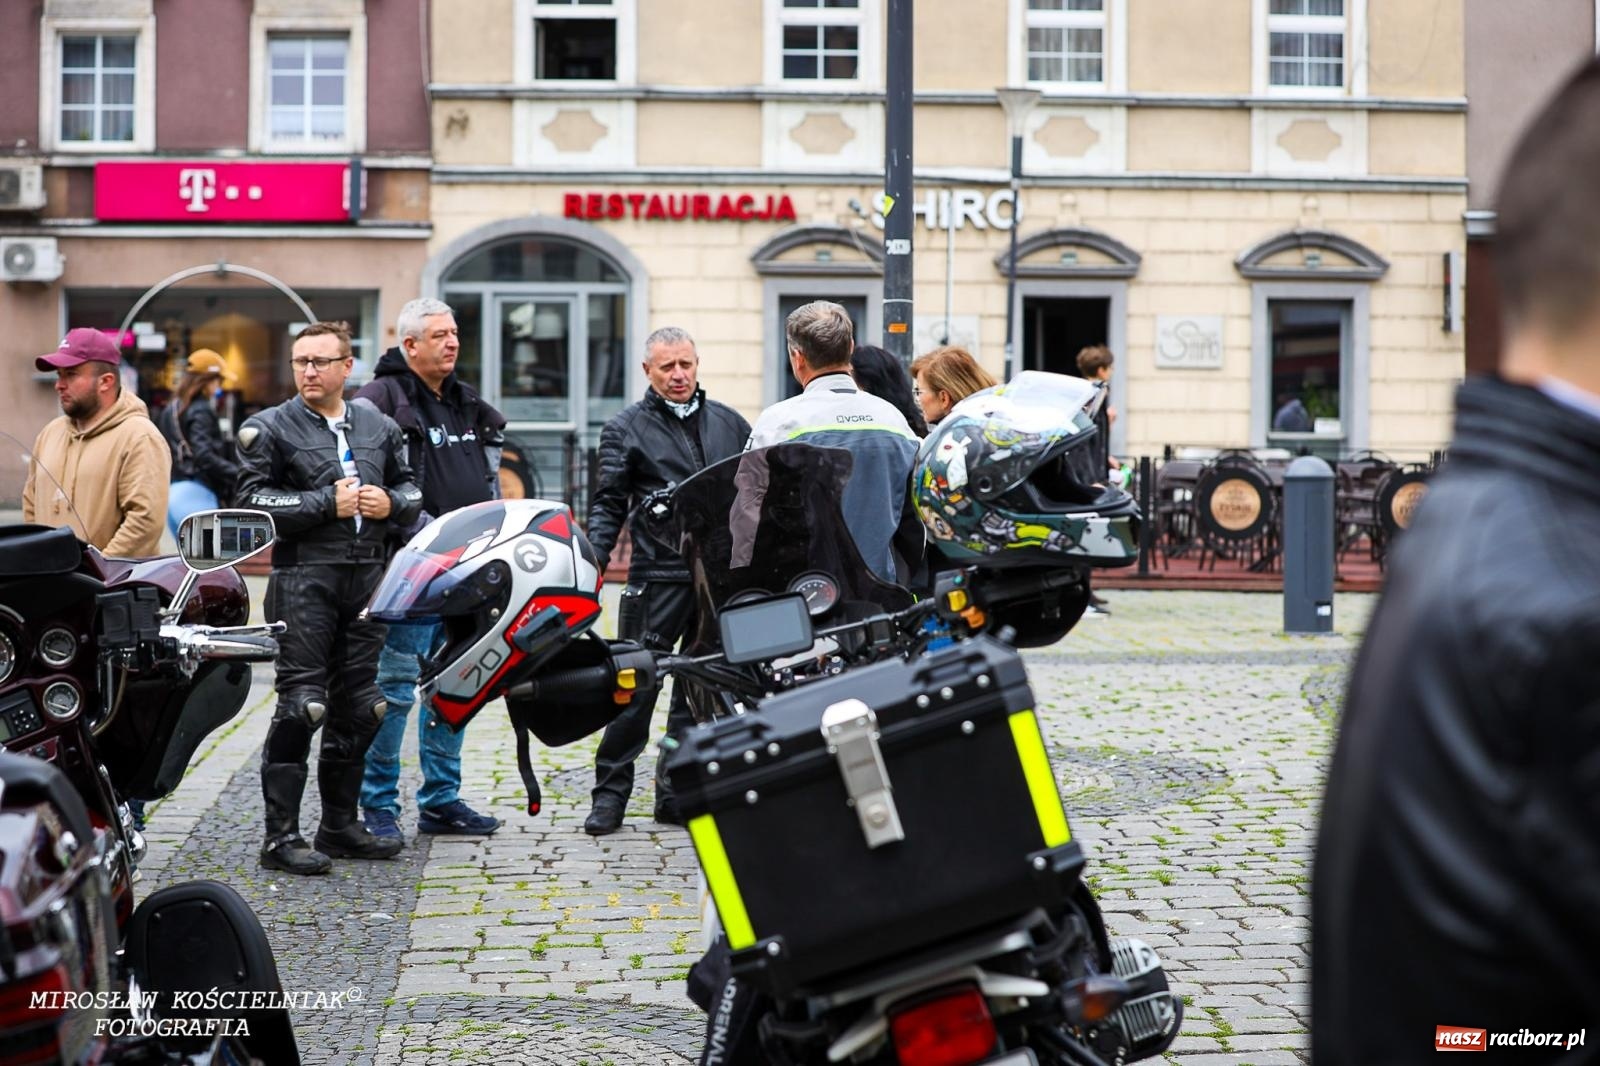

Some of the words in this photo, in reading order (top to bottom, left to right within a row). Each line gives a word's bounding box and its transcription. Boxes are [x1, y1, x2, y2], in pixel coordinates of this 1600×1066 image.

[564, 193, 798, 221] RESTAURACJA
[463, 648, 502, 689] 70
[706, 977, 737, 1066] DRENAL
